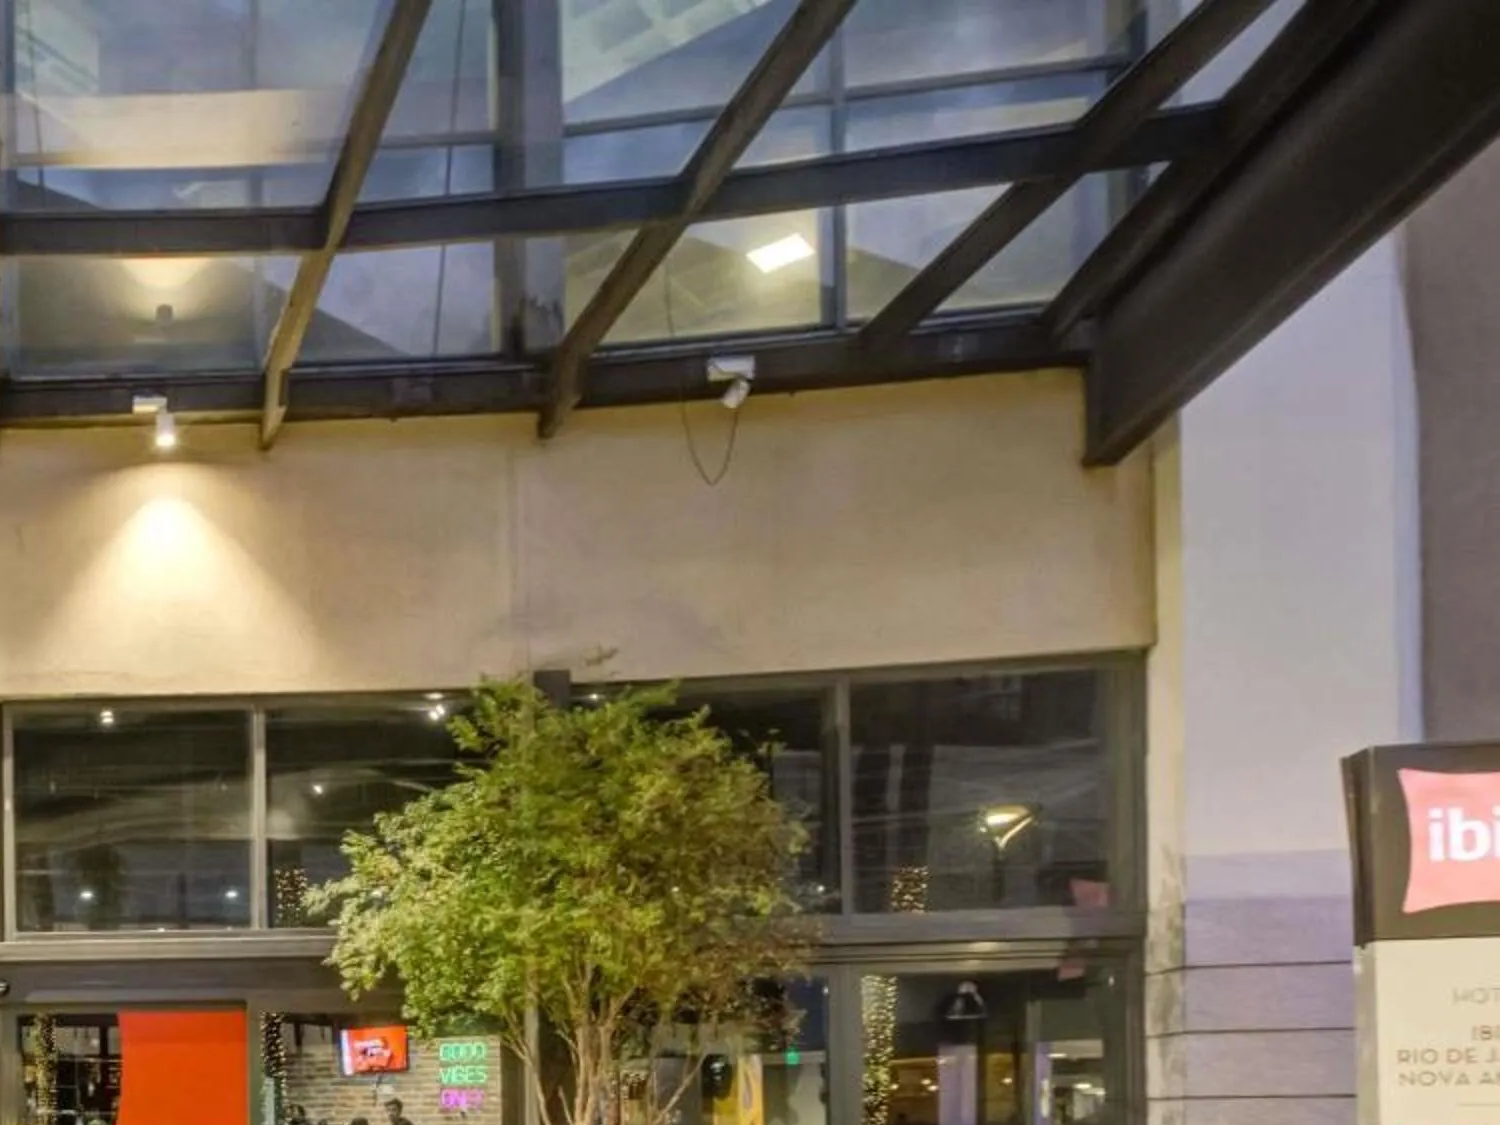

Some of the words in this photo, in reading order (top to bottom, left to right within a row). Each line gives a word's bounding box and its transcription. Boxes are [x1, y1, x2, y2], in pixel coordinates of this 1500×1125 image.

[1397, 1048, 1438, 1065] RIO
[1445, 1048, 1479, 1065] DE
[1398, 1072, 1472, 1088] NOVA
